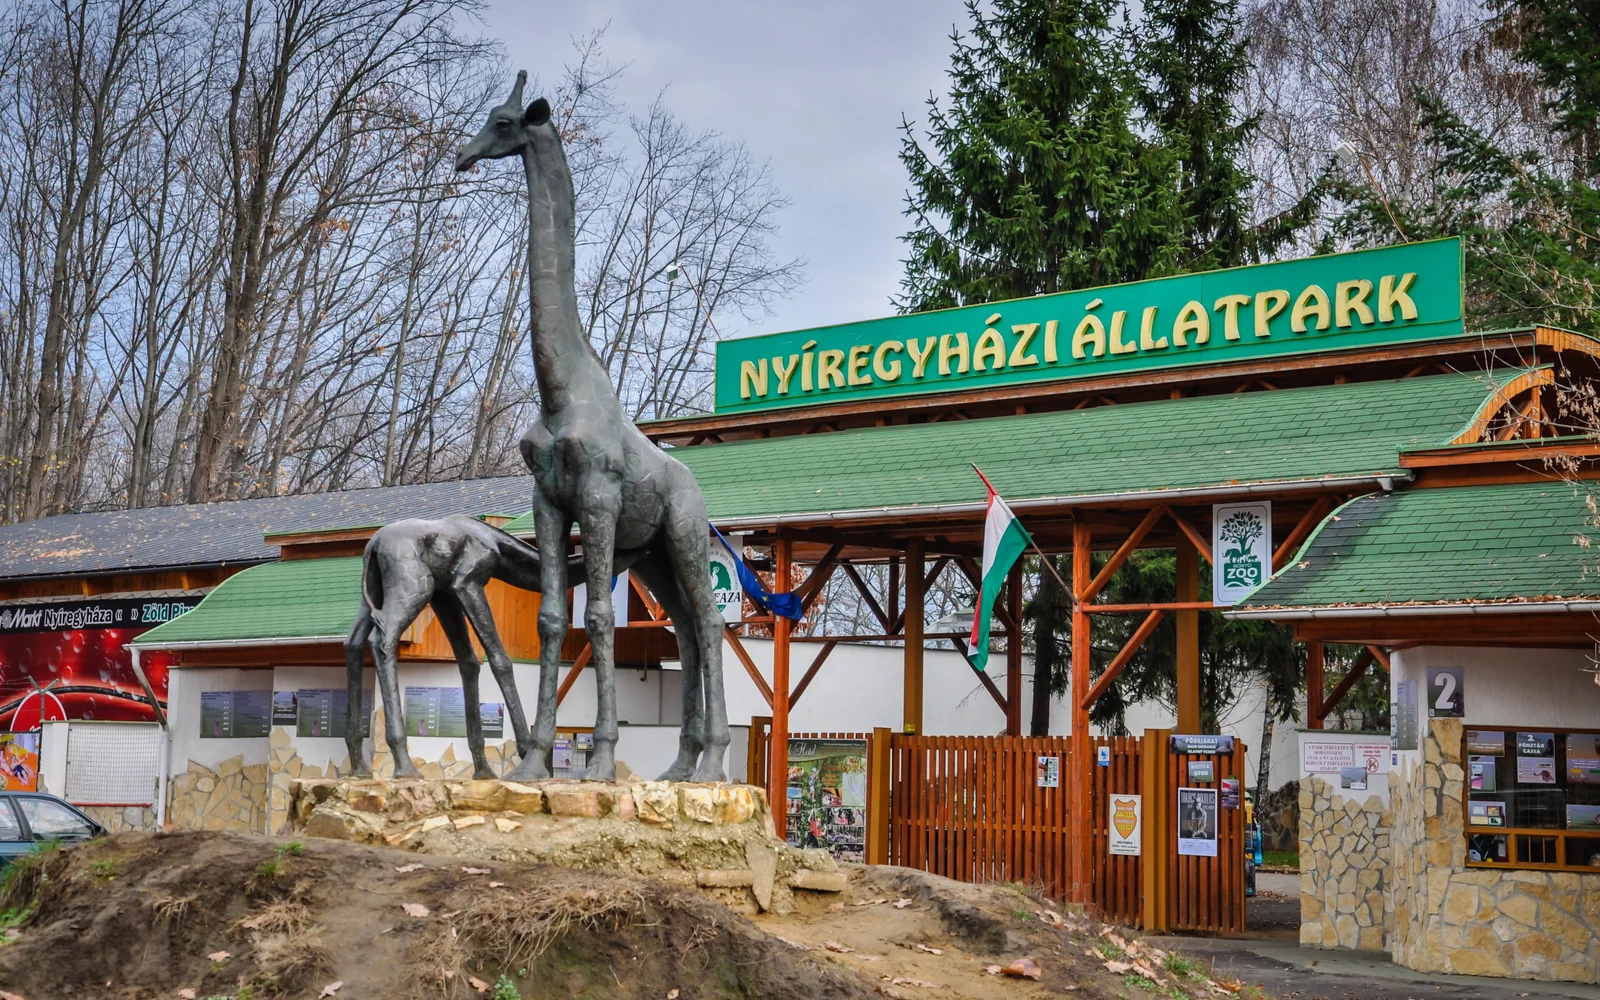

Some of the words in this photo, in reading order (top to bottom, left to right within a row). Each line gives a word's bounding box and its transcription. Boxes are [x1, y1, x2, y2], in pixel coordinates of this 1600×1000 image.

[740, 312, 1059, 399] NYÍREGYHÁZI
[1071, 272, 1418, 359] ÁLLATPARK
[1227, 567, 1258, 579] ZOO
[10, 608, 43, 628] Markt
[44, 605, 113, 630] Nyíregyháza
[141, 603, 169, 622] Zöld
[1434, 672, 1456, 710] 2
[1527, 734, 1536, 742] 2
